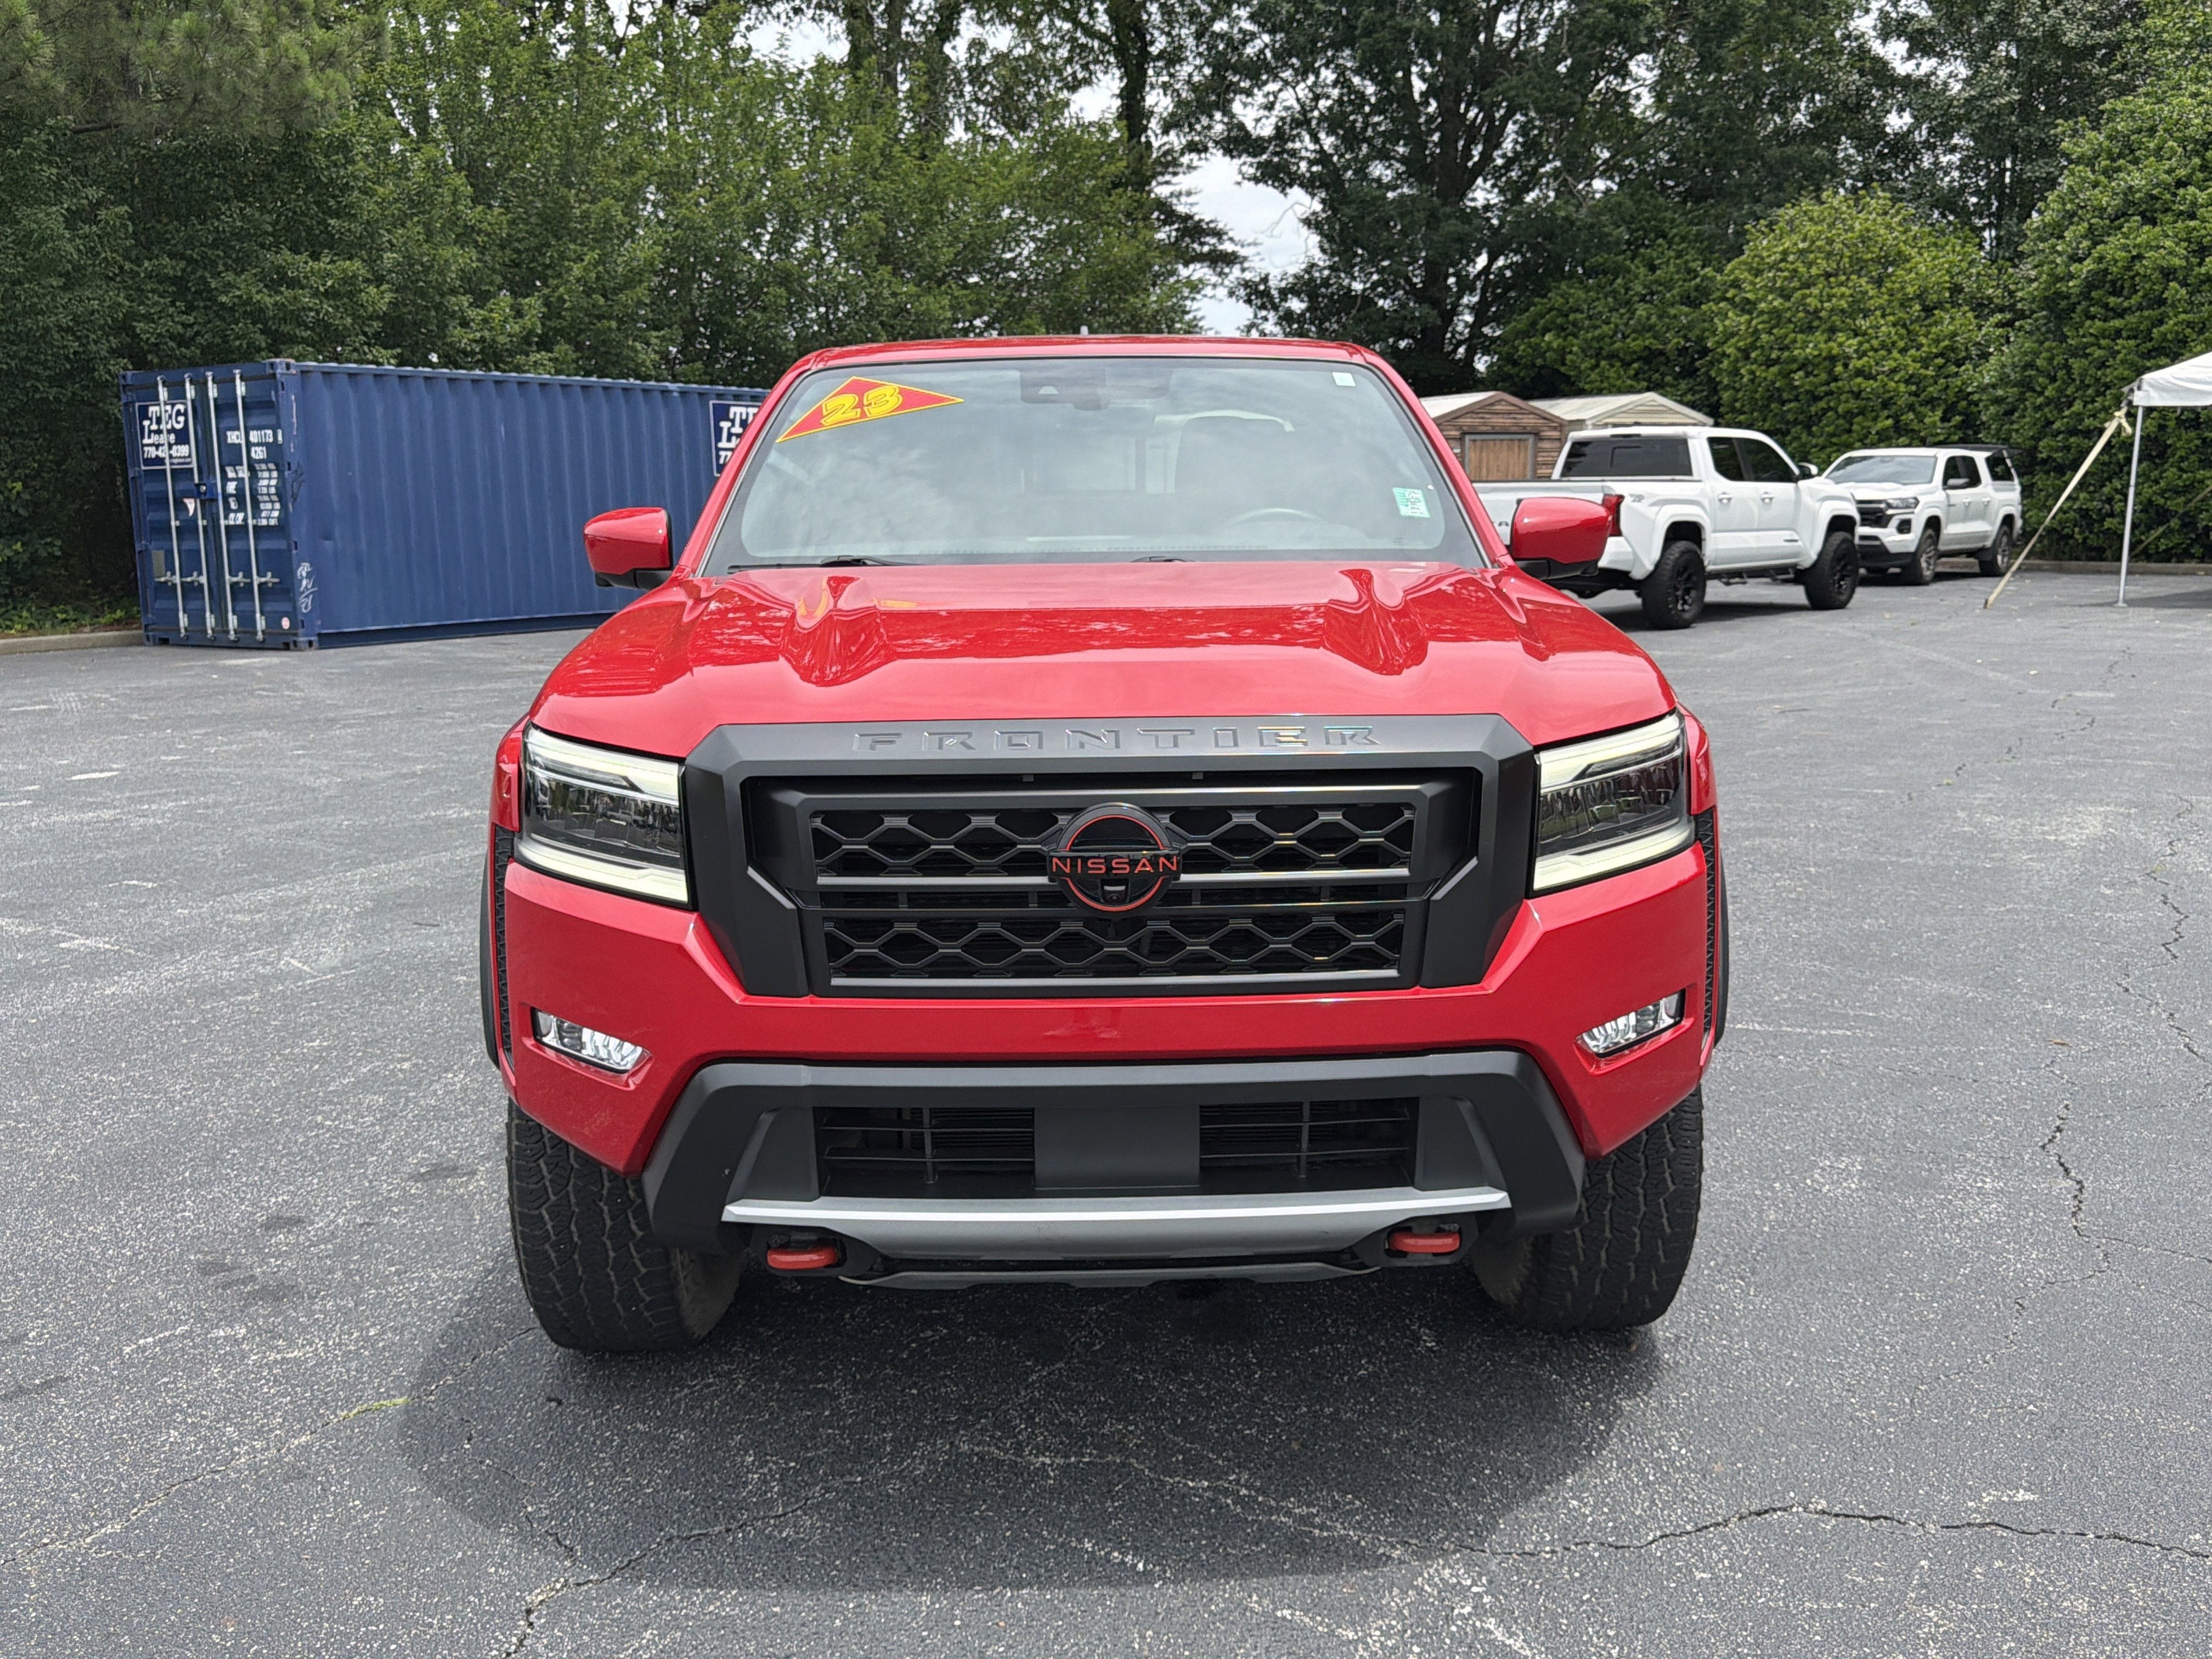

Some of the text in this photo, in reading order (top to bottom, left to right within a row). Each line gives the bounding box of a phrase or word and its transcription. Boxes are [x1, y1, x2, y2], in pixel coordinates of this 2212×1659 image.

[820, 385, 902, 426] 23
[142, 420, 175, 444] Leae
[853, 725, 1381, 751] FRONTIER
[1052, 855, 1178, 874] NISSAN
